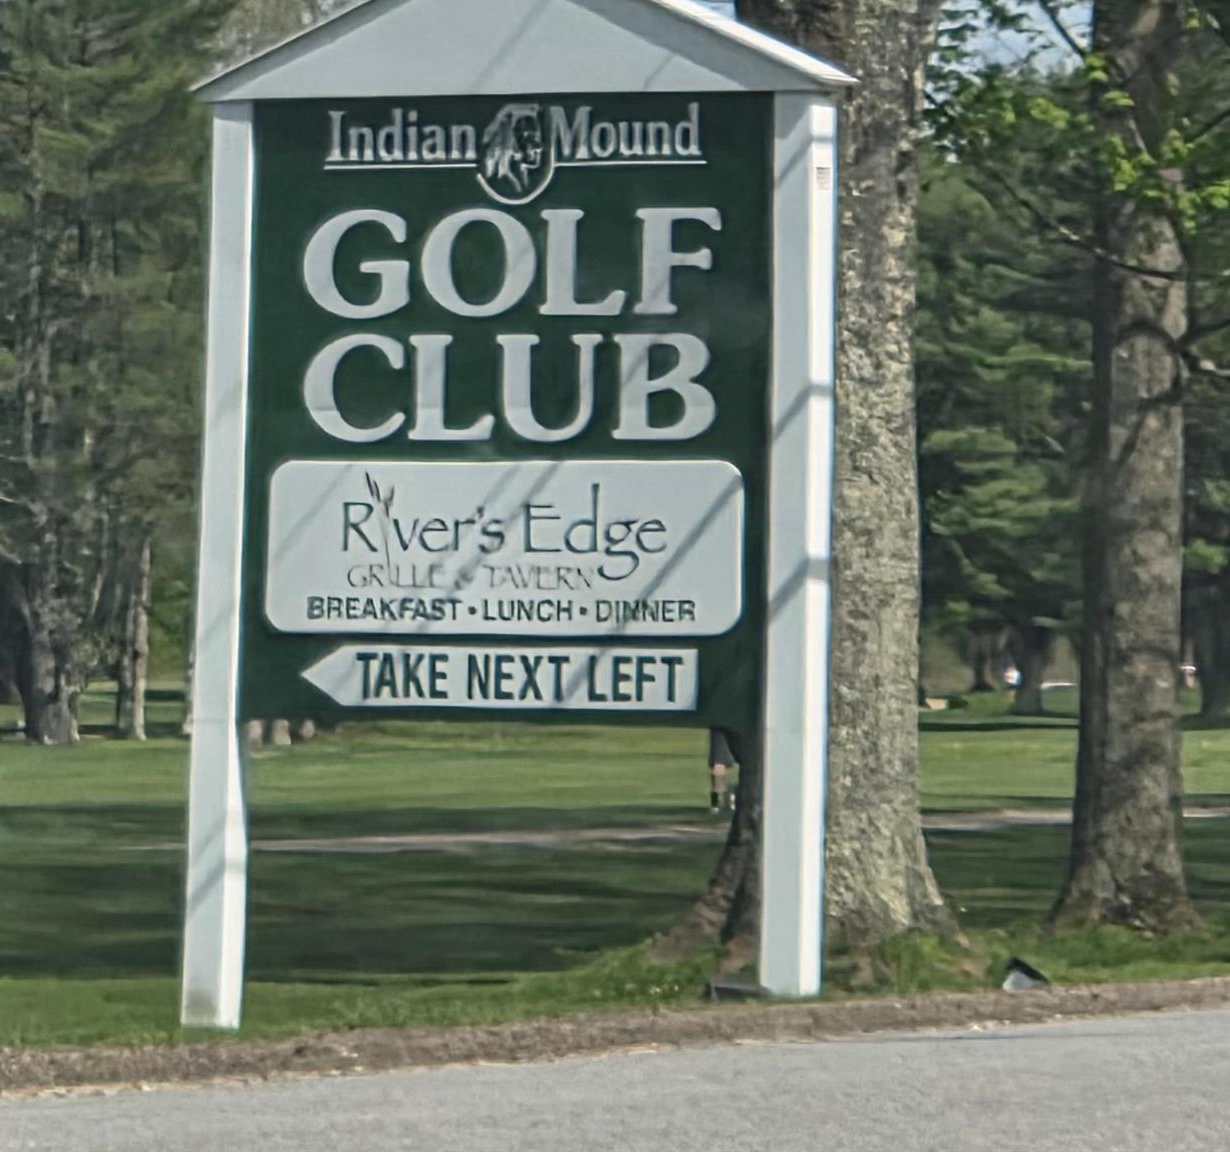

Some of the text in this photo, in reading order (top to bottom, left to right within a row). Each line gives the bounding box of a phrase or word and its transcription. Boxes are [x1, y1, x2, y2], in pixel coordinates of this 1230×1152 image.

[327, 102, 702, 162] Indian Mound
[303, 206, 722, 319] GOLF
[303, 332, 717, 443] CLUB
[522, 483, 667, 580] Edge
[482, 563, 594, 590] TAVERN
[306, 595, 696, 623] BREAKFAST LUNCH DINNER
[356, 652, 686, 703] TAKE NEXT LEFT
